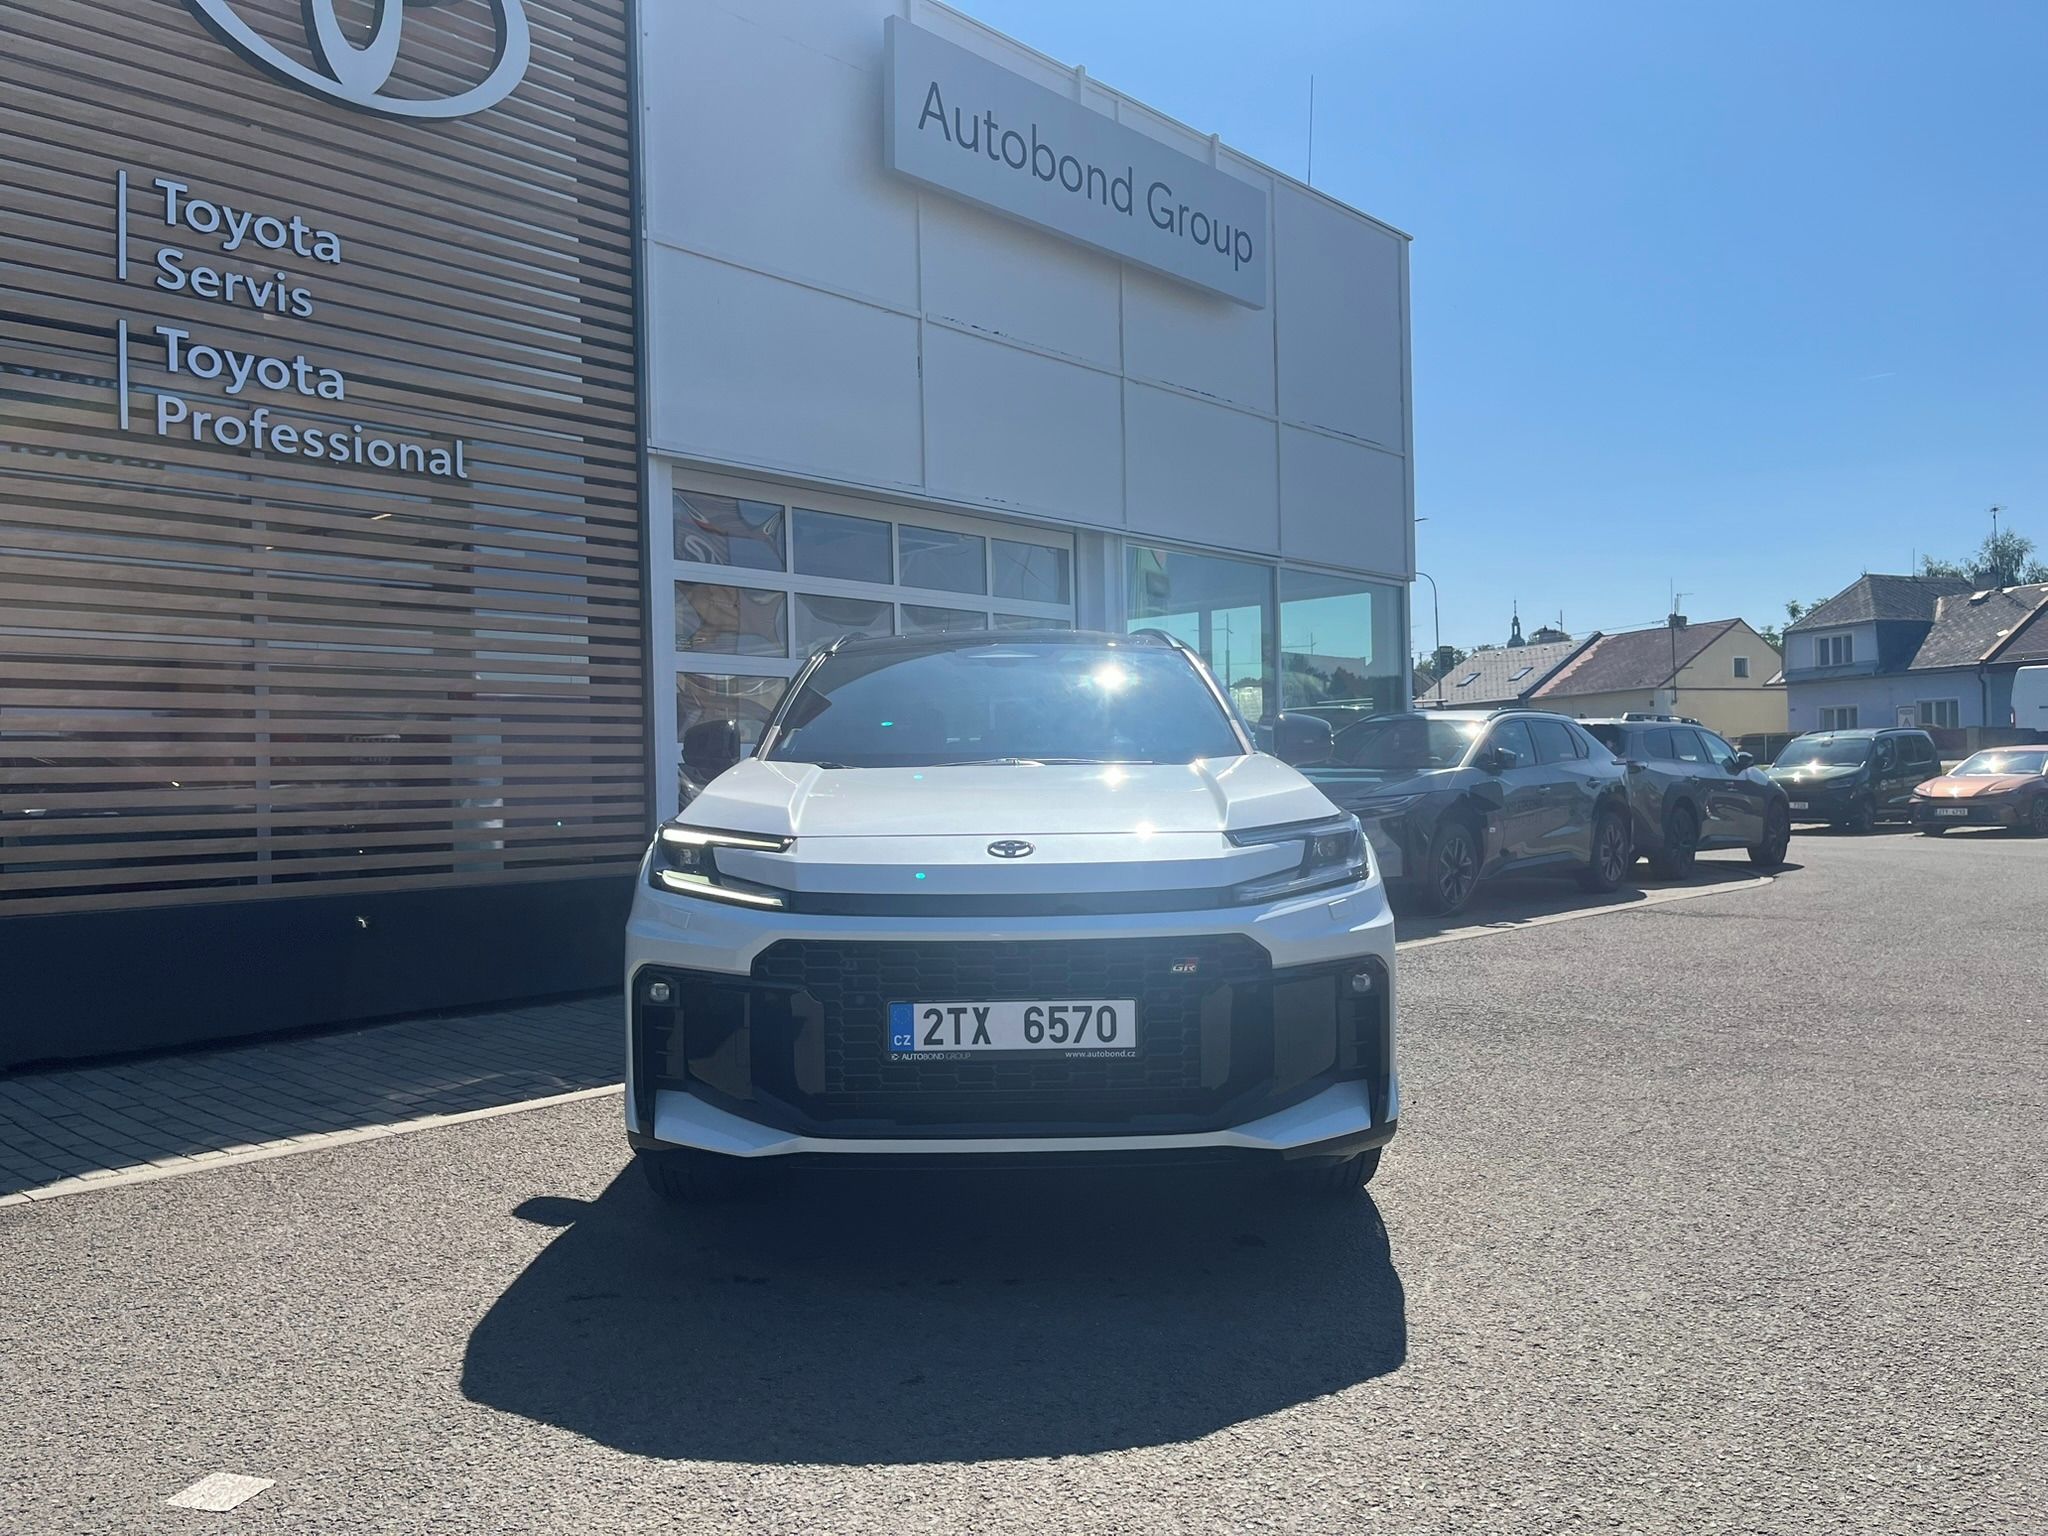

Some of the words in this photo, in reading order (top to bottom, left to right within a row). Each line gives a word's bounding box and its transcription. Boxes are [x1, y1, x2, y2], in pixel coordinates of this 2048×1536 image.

[918, 81, 1133, 216] Autobond
[1147, 182, 1253, 271] Group
[154, 178, 341, 263] Toyota
[156, 248, 313, 317] Servis
[155, 325, 344, 400] Toyota
[157, 394, 467, 478] Professional
[893, 1034, 912, 1047] CZ
[901, 1052, 945, 1061] AUTOBOND
[923, 1007, 992, 1046] 2TX
[1023, 1005, 1117, 1044] 6570
[1065, 1050, 1136, 1058] www.autobond.cz
